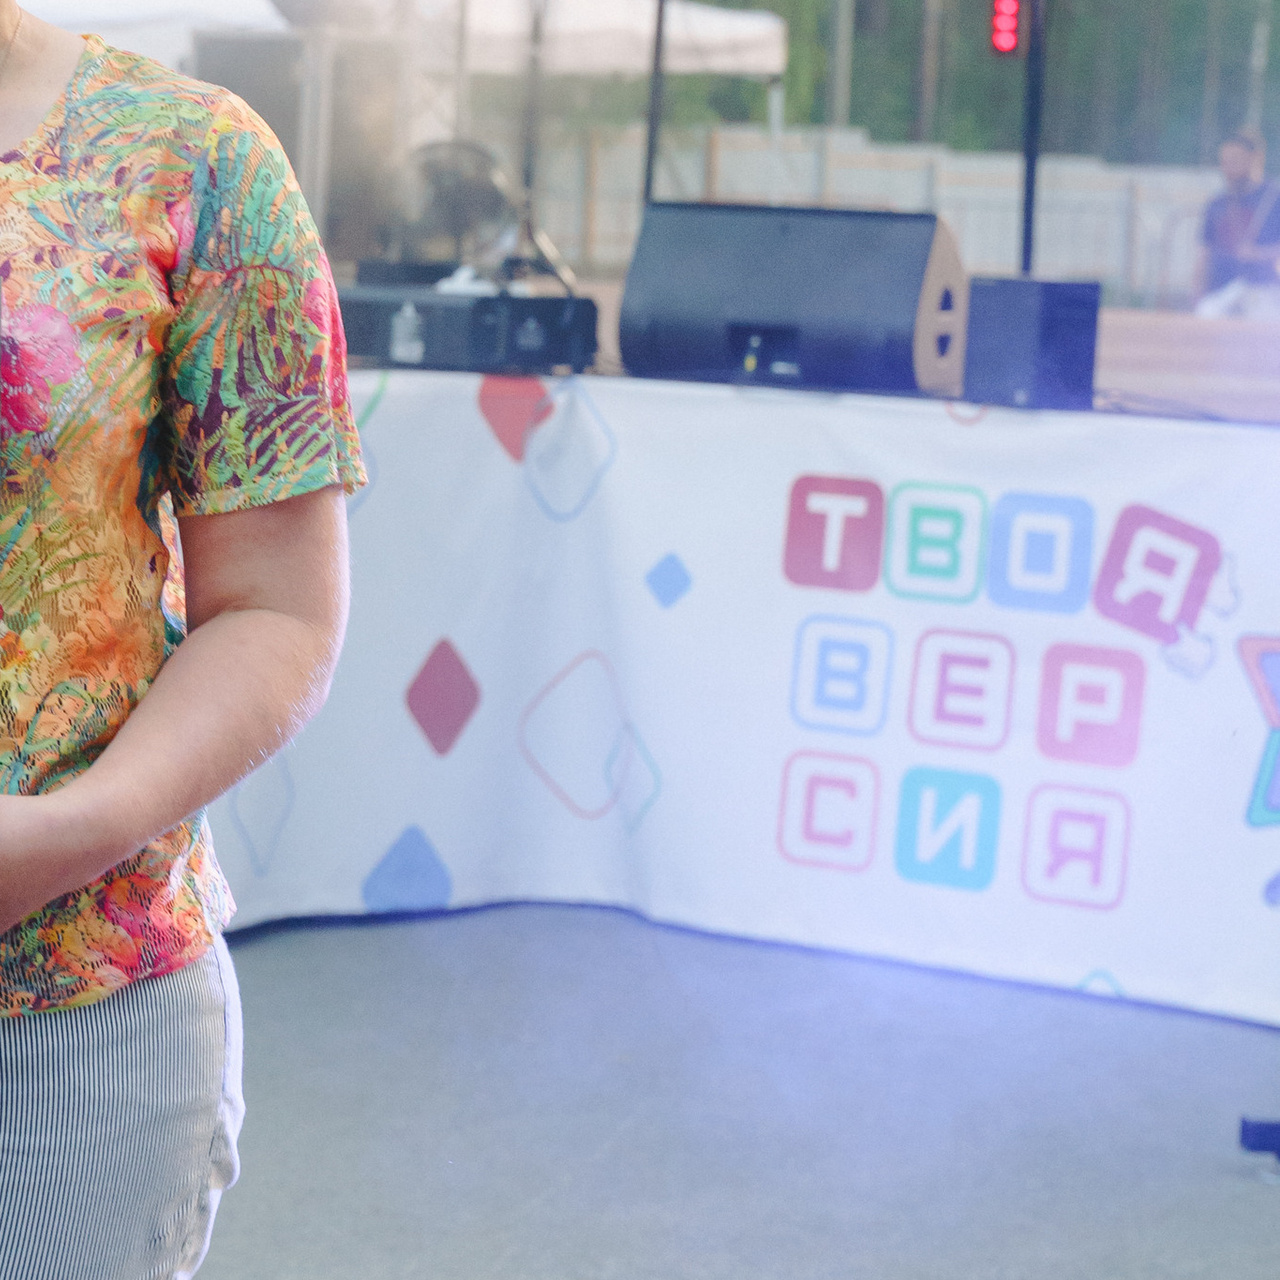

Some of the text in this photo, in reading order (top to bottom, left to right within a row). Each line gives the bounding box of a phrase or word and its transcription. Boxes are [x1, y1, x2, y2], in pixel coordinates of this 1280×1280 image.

[804, 490, 1204, 626] ТВОЯ
[811, 634, 1129, 746] ВЕР
[799, 771, 1109, 887] СИЯ
